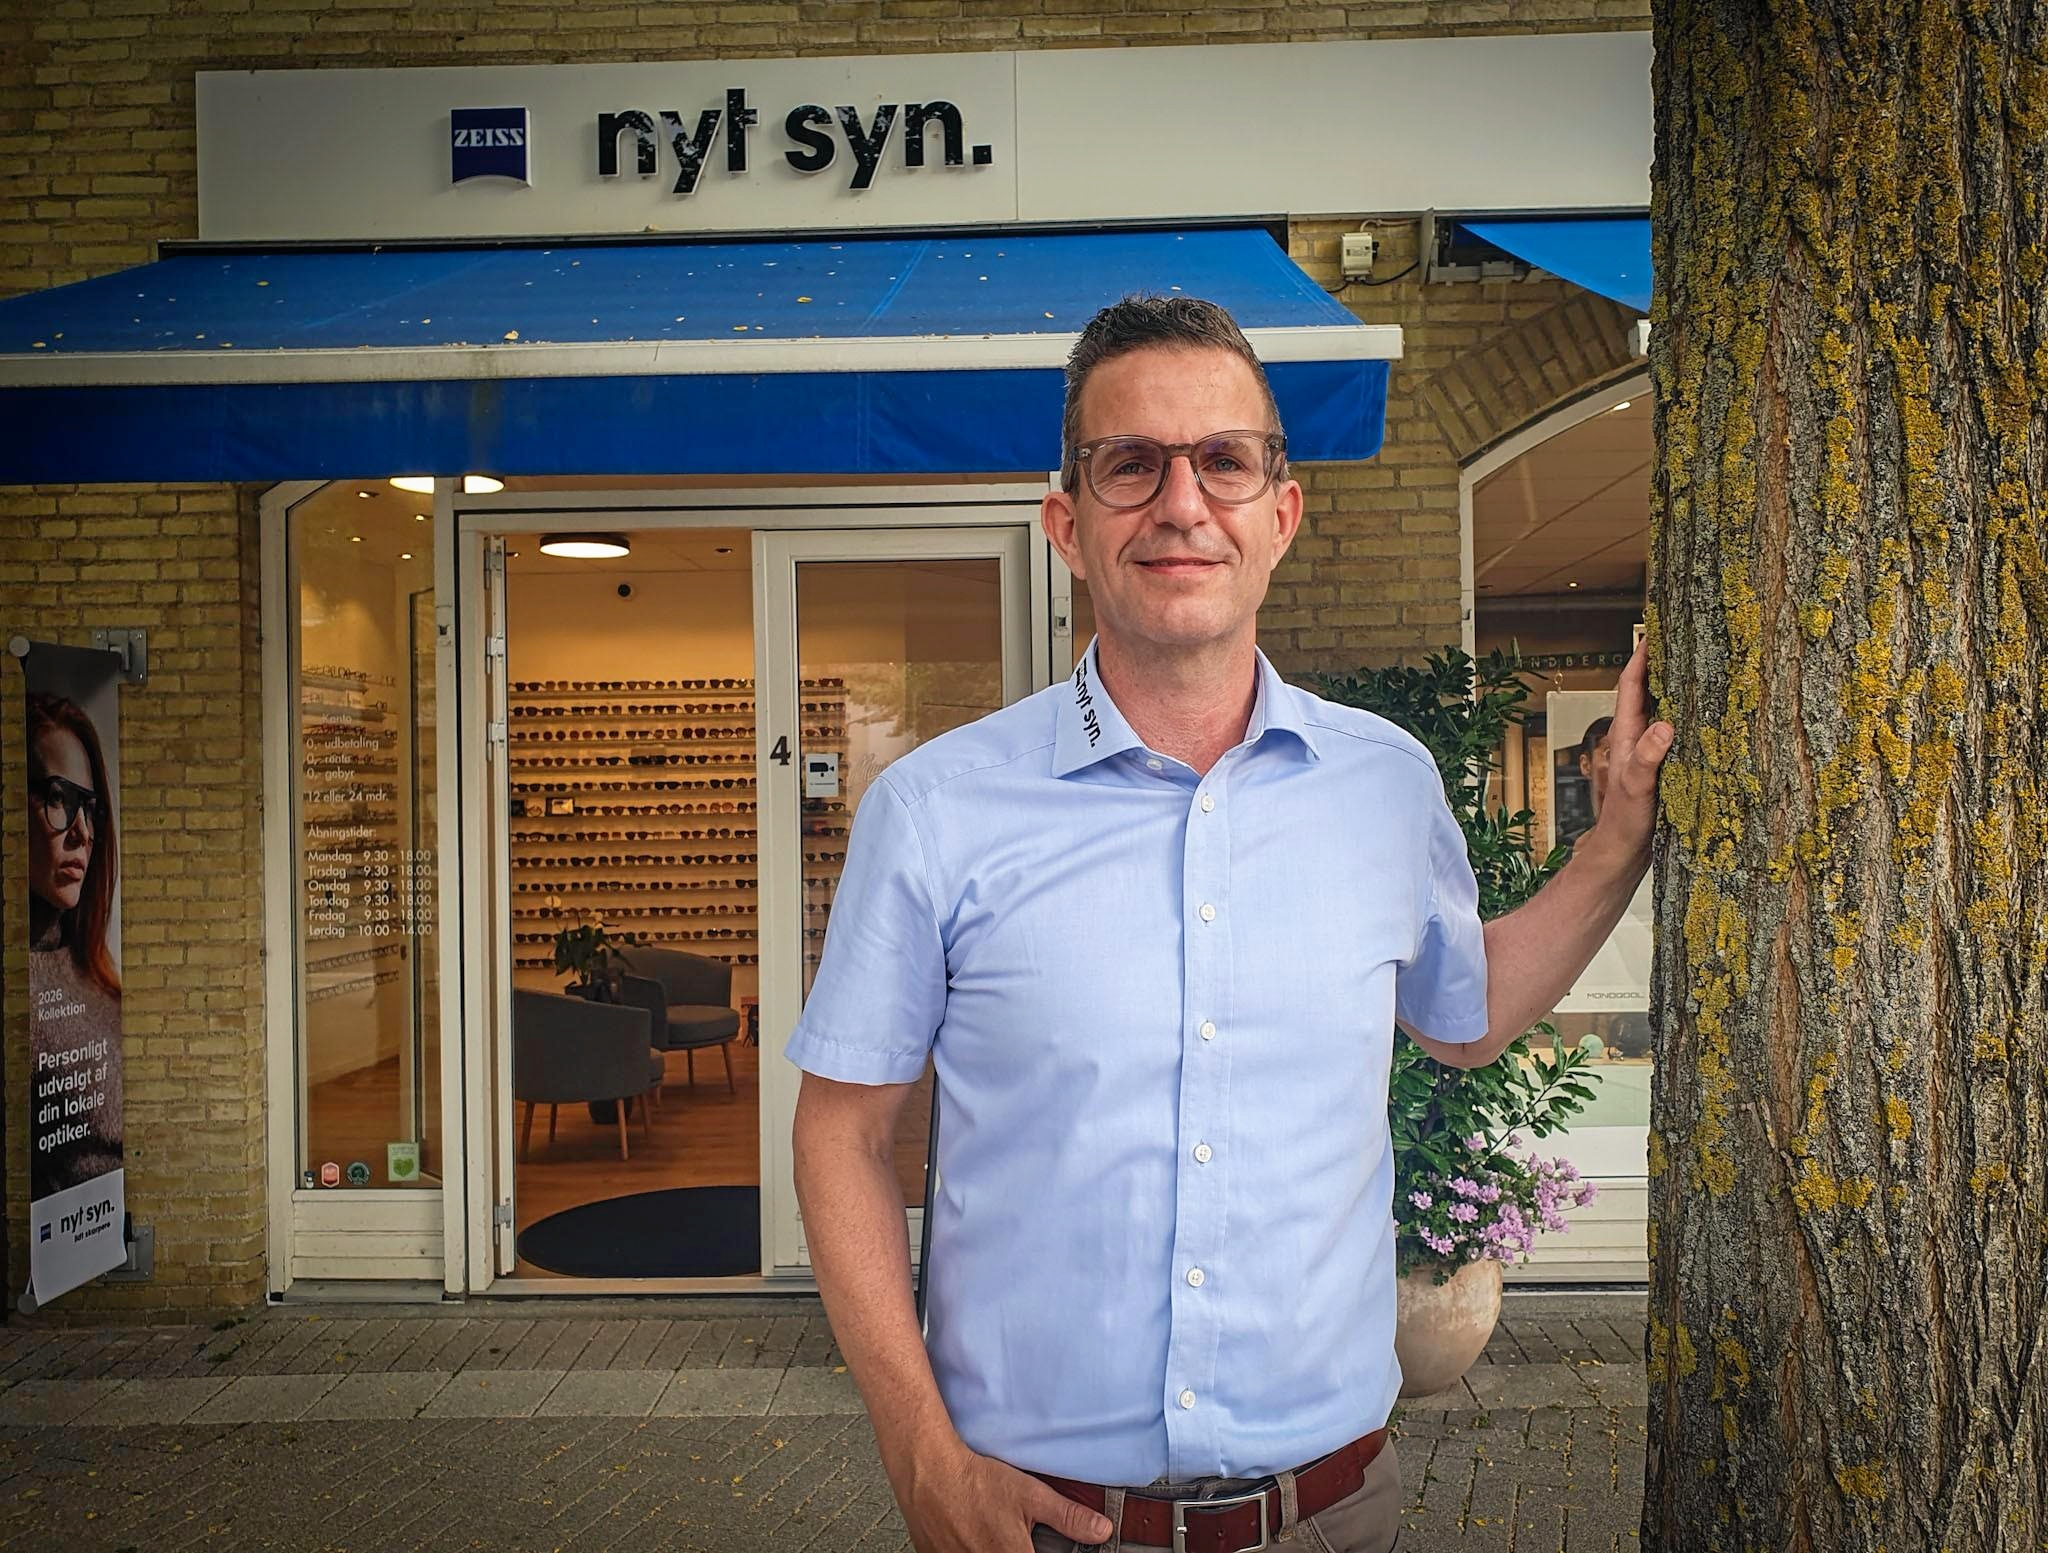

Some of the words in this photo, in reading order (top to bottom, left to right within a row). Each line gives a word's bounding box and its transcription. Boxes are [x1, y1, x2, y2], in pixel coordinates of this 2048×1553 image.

[453, 127, 524, 148] ZEISS
[598, 88, 760, 195] nyt
[783, 100, 993, 191] syn.
[1517, 654, 1623, 668] INDBERG
[1076, 681, 1093, 709] nyt
[1083, 708, 1101, 748] syn.
[325, 735, 379, 751] udbetaling
[770, 736, 791, 766] 4
[325, 766, 355, 781] gebyr
[308, 792, 320, 803] 12
[323, 790, 345, 802] eller
[349, 791, 362, 801] 24
[366, 789, 389, 802] mdr.
[308, 824, 377, 840] Åbningstider:
[308, 849, 352, 864] Mandag
[363, 850, 388, 861] 9.30
[400, 850, 431, 861] 18.00
[308, 864, 346, 879] Tirsdag
[363, 865, 389, 877] 9.30
[401, 865, 432, 876] 18.00
[308, 879, 350, 893] Onsdag
[364, 880, 389, 891] 9.30
[401, 880, 432, 891] 18.00
[309, 894, 349, 908] Torsdag
[364, 895, 390, 907] 9.30
[401, 895, 432, 906] 18.00
[309, 909, 345, 923] Fredag
[364, 909, 390, 921] 9.30
[401, 909, 432, 921] 18.00
[309, 924, 345, 938] Lørdag
[359, 925, 390, 937] 10.00
[401, 924, 432, 936] 14.00
[38, 988, 62, 1005] 2026
[38, 1003, 86, 1022] Kollektion
[38, 1038, 108, 1072] Personligt
[39, 1068, 91, 1098] udvalgt
[95, 1062, 108, 1082] af
[39, 1103, 59, 1124] din
[64, 1090, 105, 1116] lokale
[39, 1122, 91, 1153] optiker.
[60, 1206, 84, 1234] nyt
[86, 1199, 115, 1223] syn.
